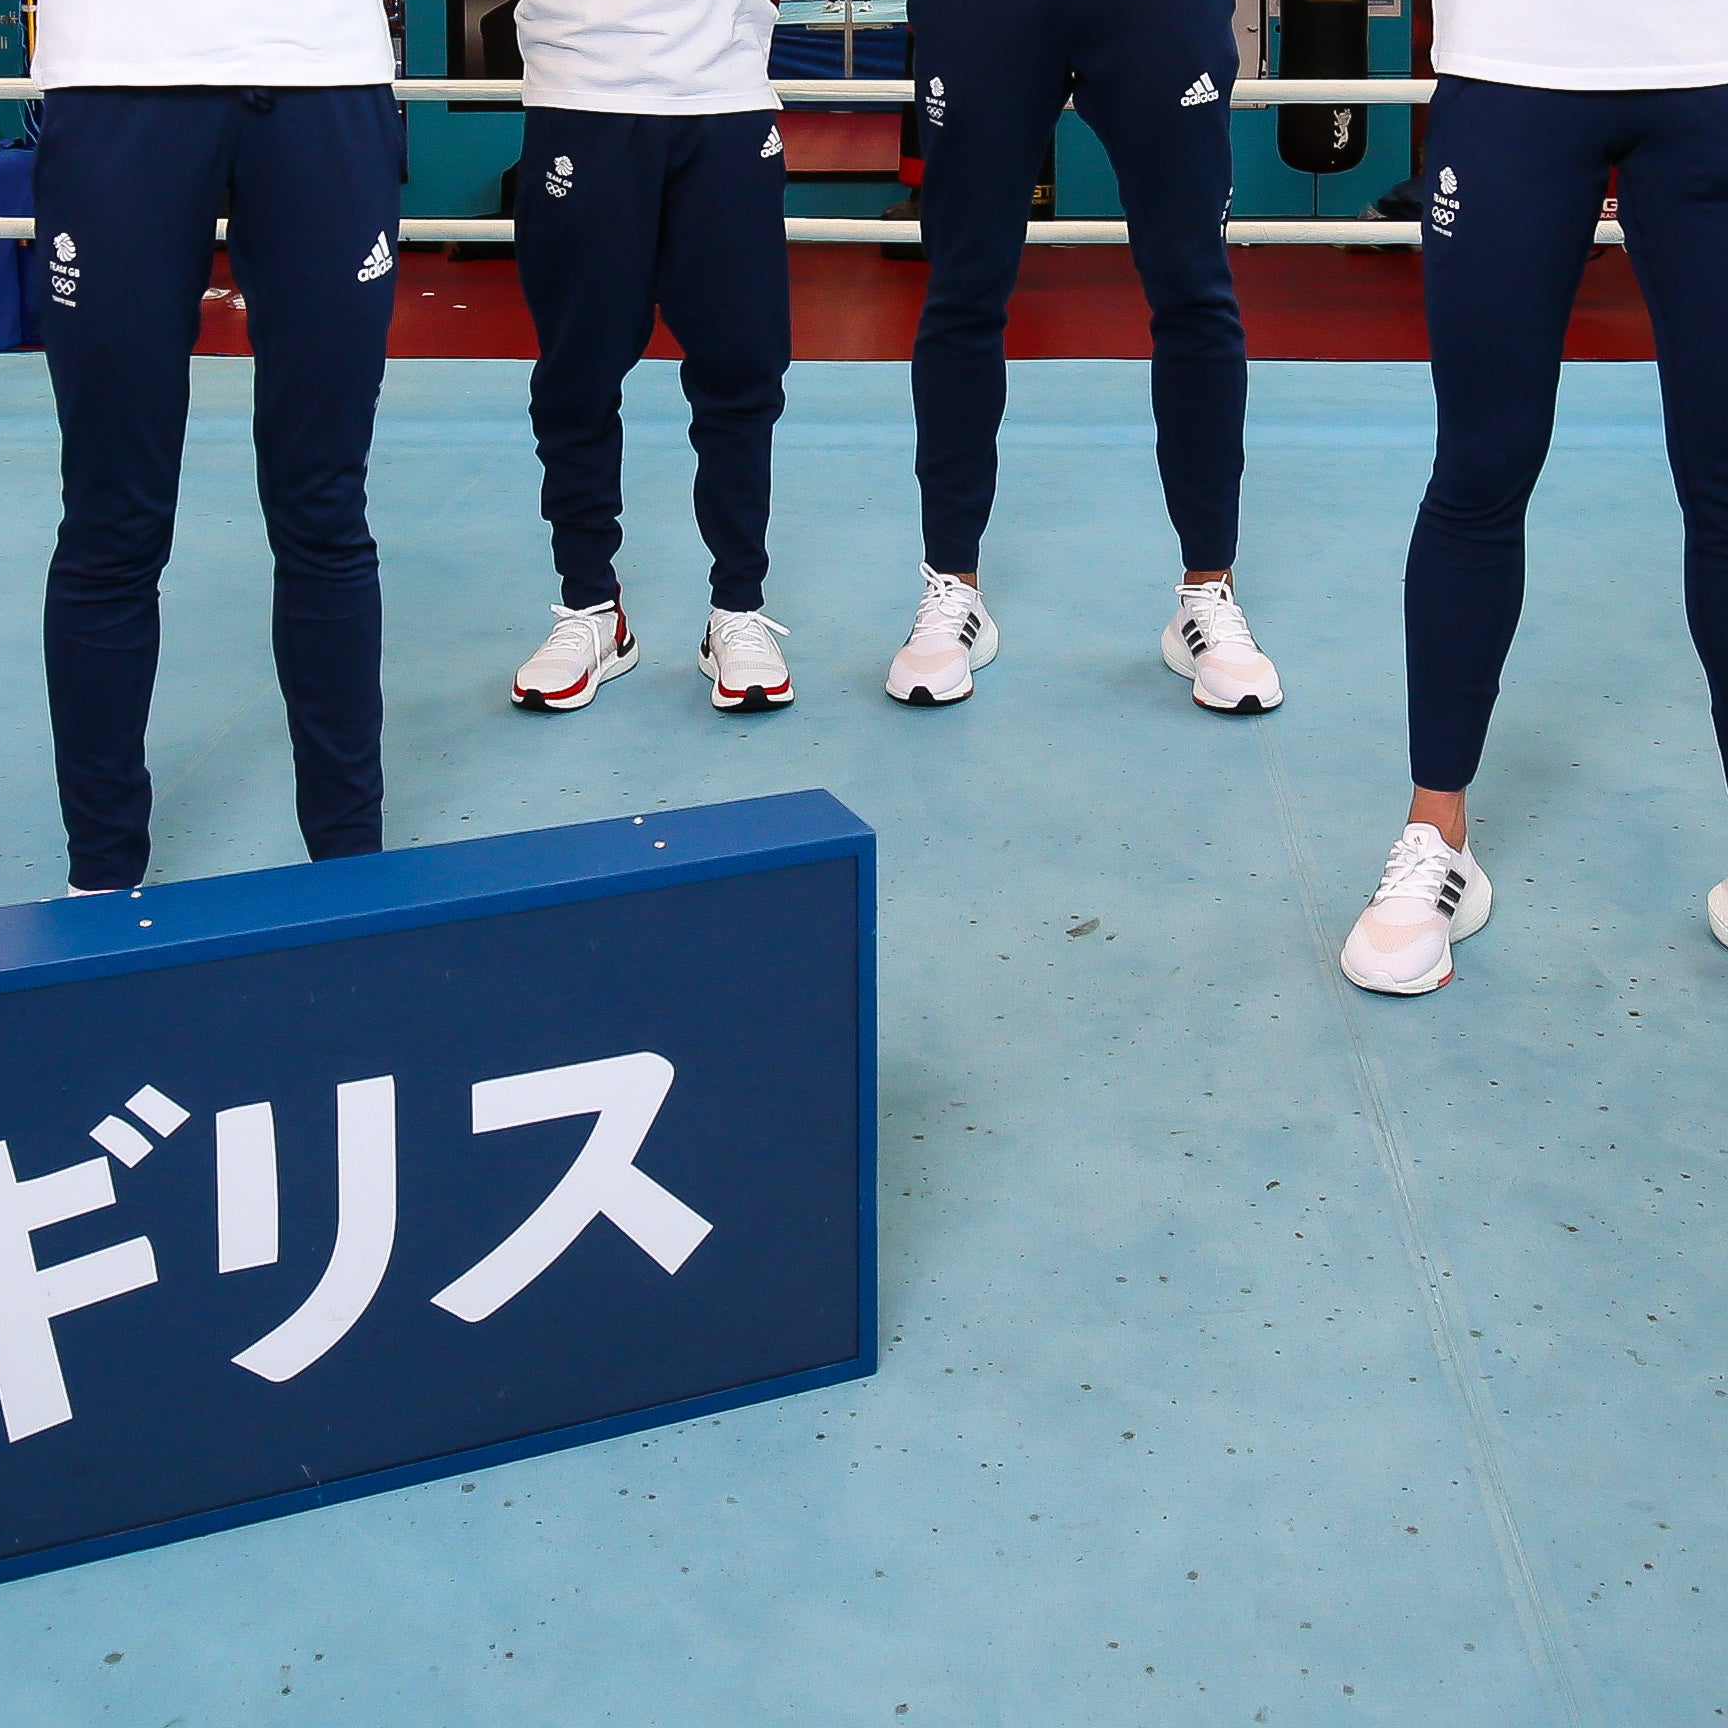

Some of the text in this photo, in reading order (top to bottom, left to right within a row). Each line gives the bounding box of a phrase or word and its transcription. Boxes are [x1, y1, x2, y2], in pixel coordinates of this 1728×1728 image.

[1180, 89, 1220, 107] adidas
[545, 171, 573, 189] TEAM GB
[1433, 192, 1460, 210] TEAM GB
[49, 261, 81, 278] TEAM GB
